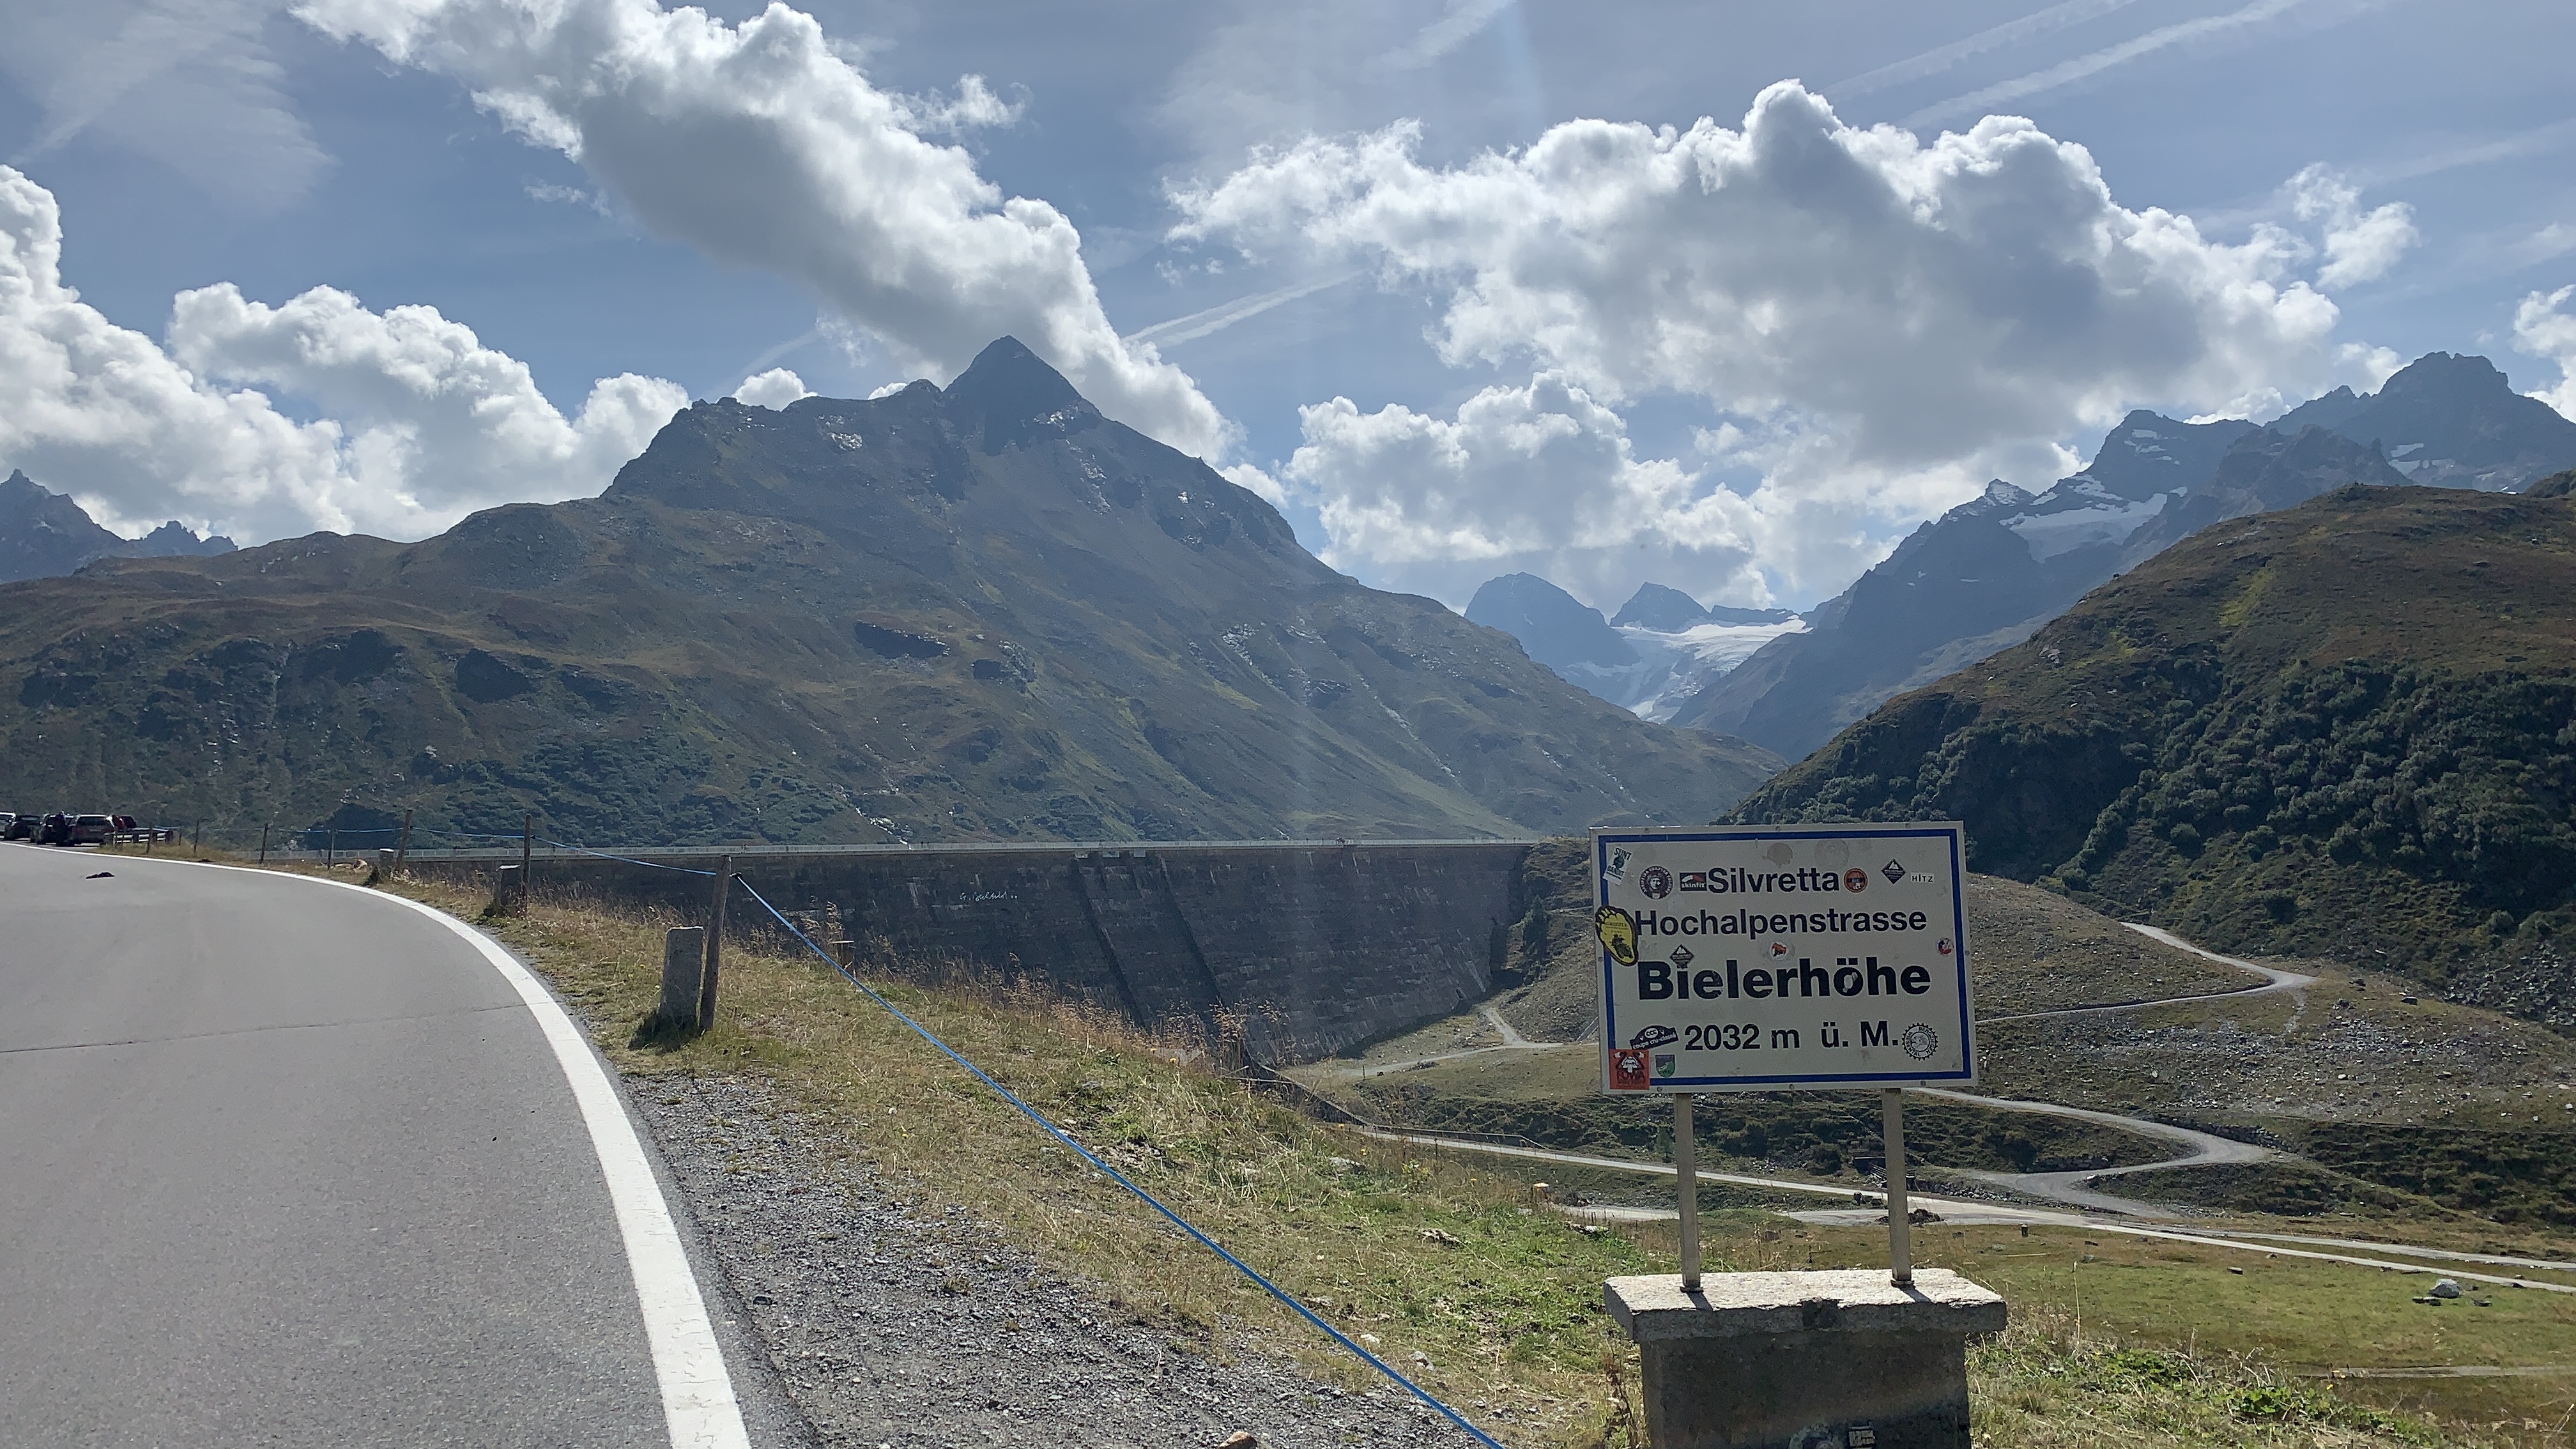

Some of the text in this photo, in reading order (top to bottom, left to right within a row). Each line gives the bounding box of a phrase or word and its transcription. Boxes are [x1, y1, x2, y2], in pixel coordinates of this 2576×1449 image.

[1708, 867, 1840, 893] Silvretta
[1636, 908, 1927, 940] Hochalpenstrasse
[1637, 957, 1931, 1000] Bielerhöhe
[1684, 1020, 1899, 1051] 2032 m ü. M.
